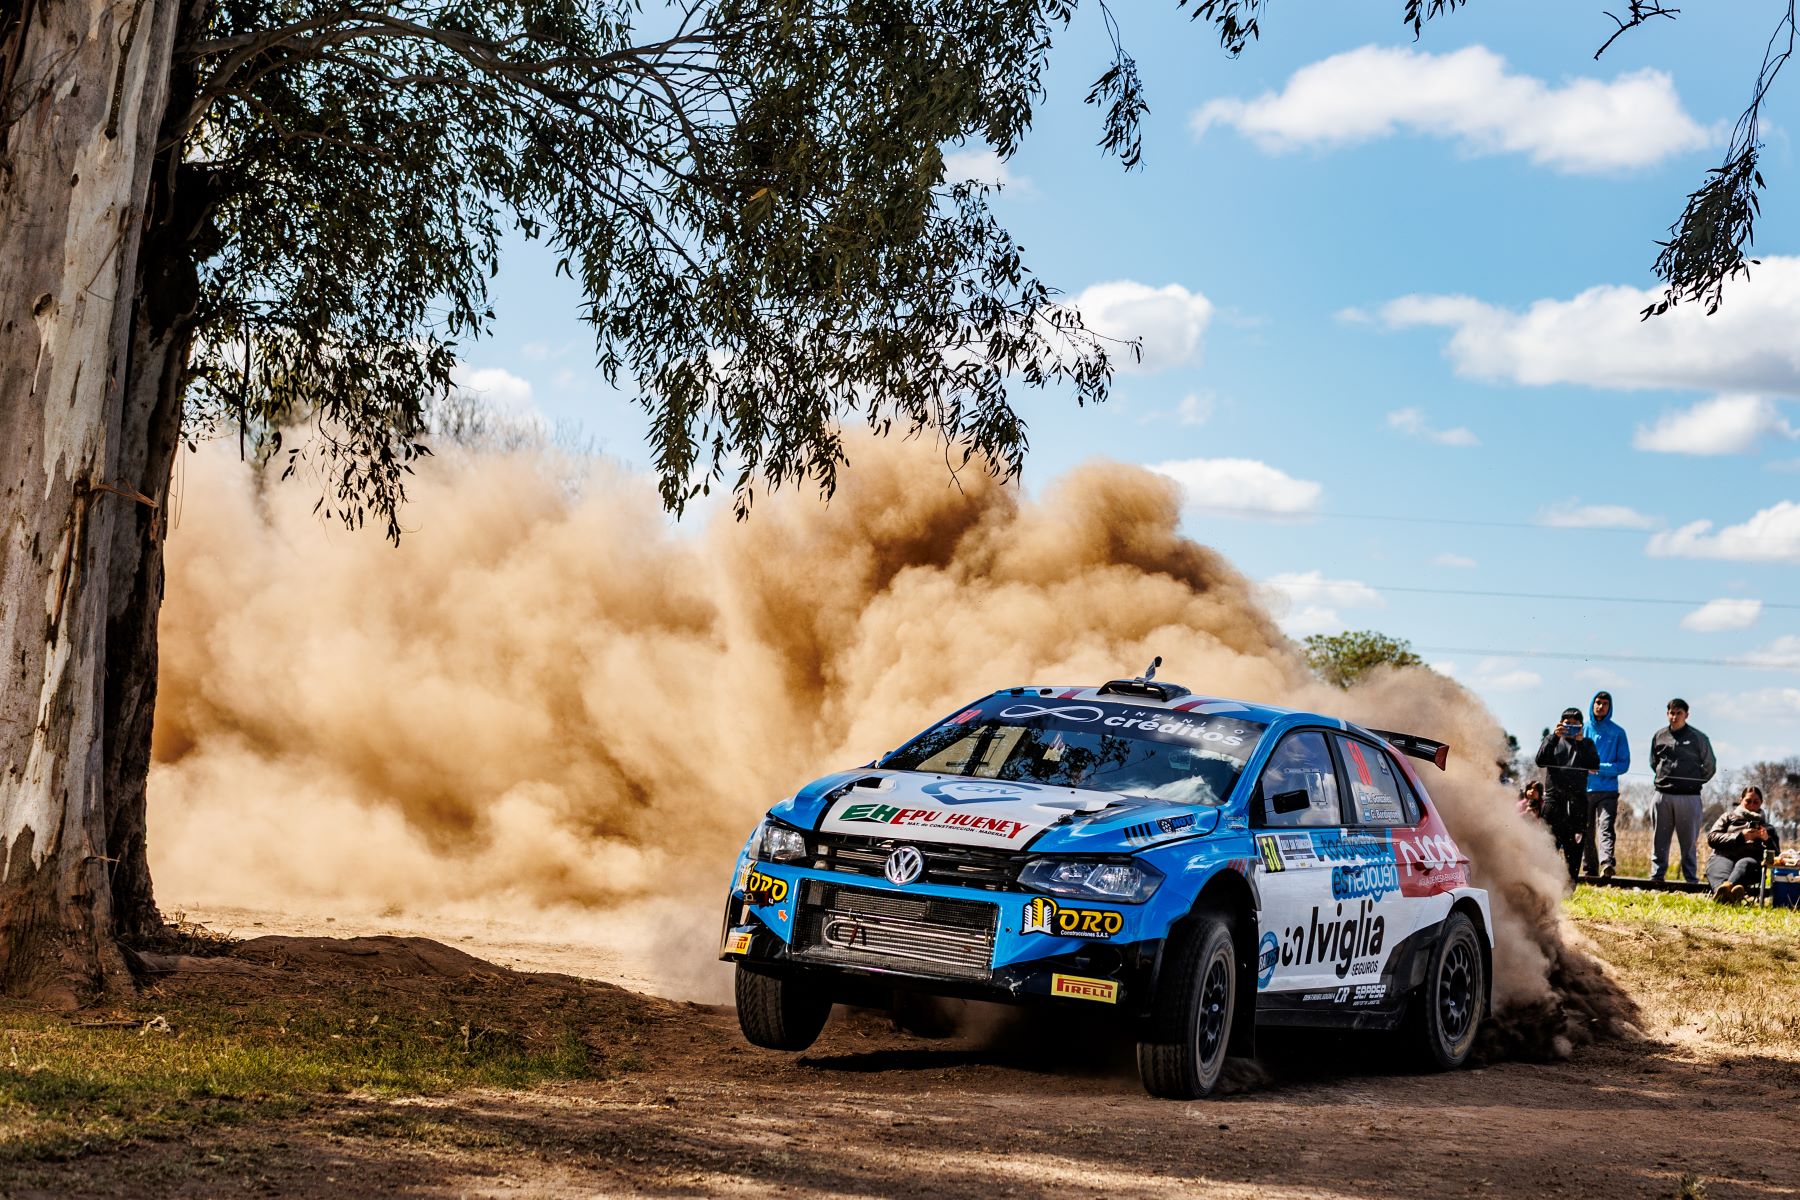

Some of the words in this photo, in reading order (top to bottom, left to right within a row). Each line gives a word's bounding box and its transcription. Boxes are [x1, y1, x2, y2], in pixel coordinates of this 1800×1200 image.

[1104, 714, 1245, 747] créditos
[1122, 709, 1245, 734] INFINITO
[944, 813, 1029, 839] HUENEY
[978, 829, 1007, 838] MADERAS
[886, 847, 923, 884] VW
[1261, 837, 1281, 872] 50
[1060, 930, 1096, 938] Construcciones
[1351, 960, 1378, 976] SEGUROS
[1057, 977, 1113, 998] PIRELLI
